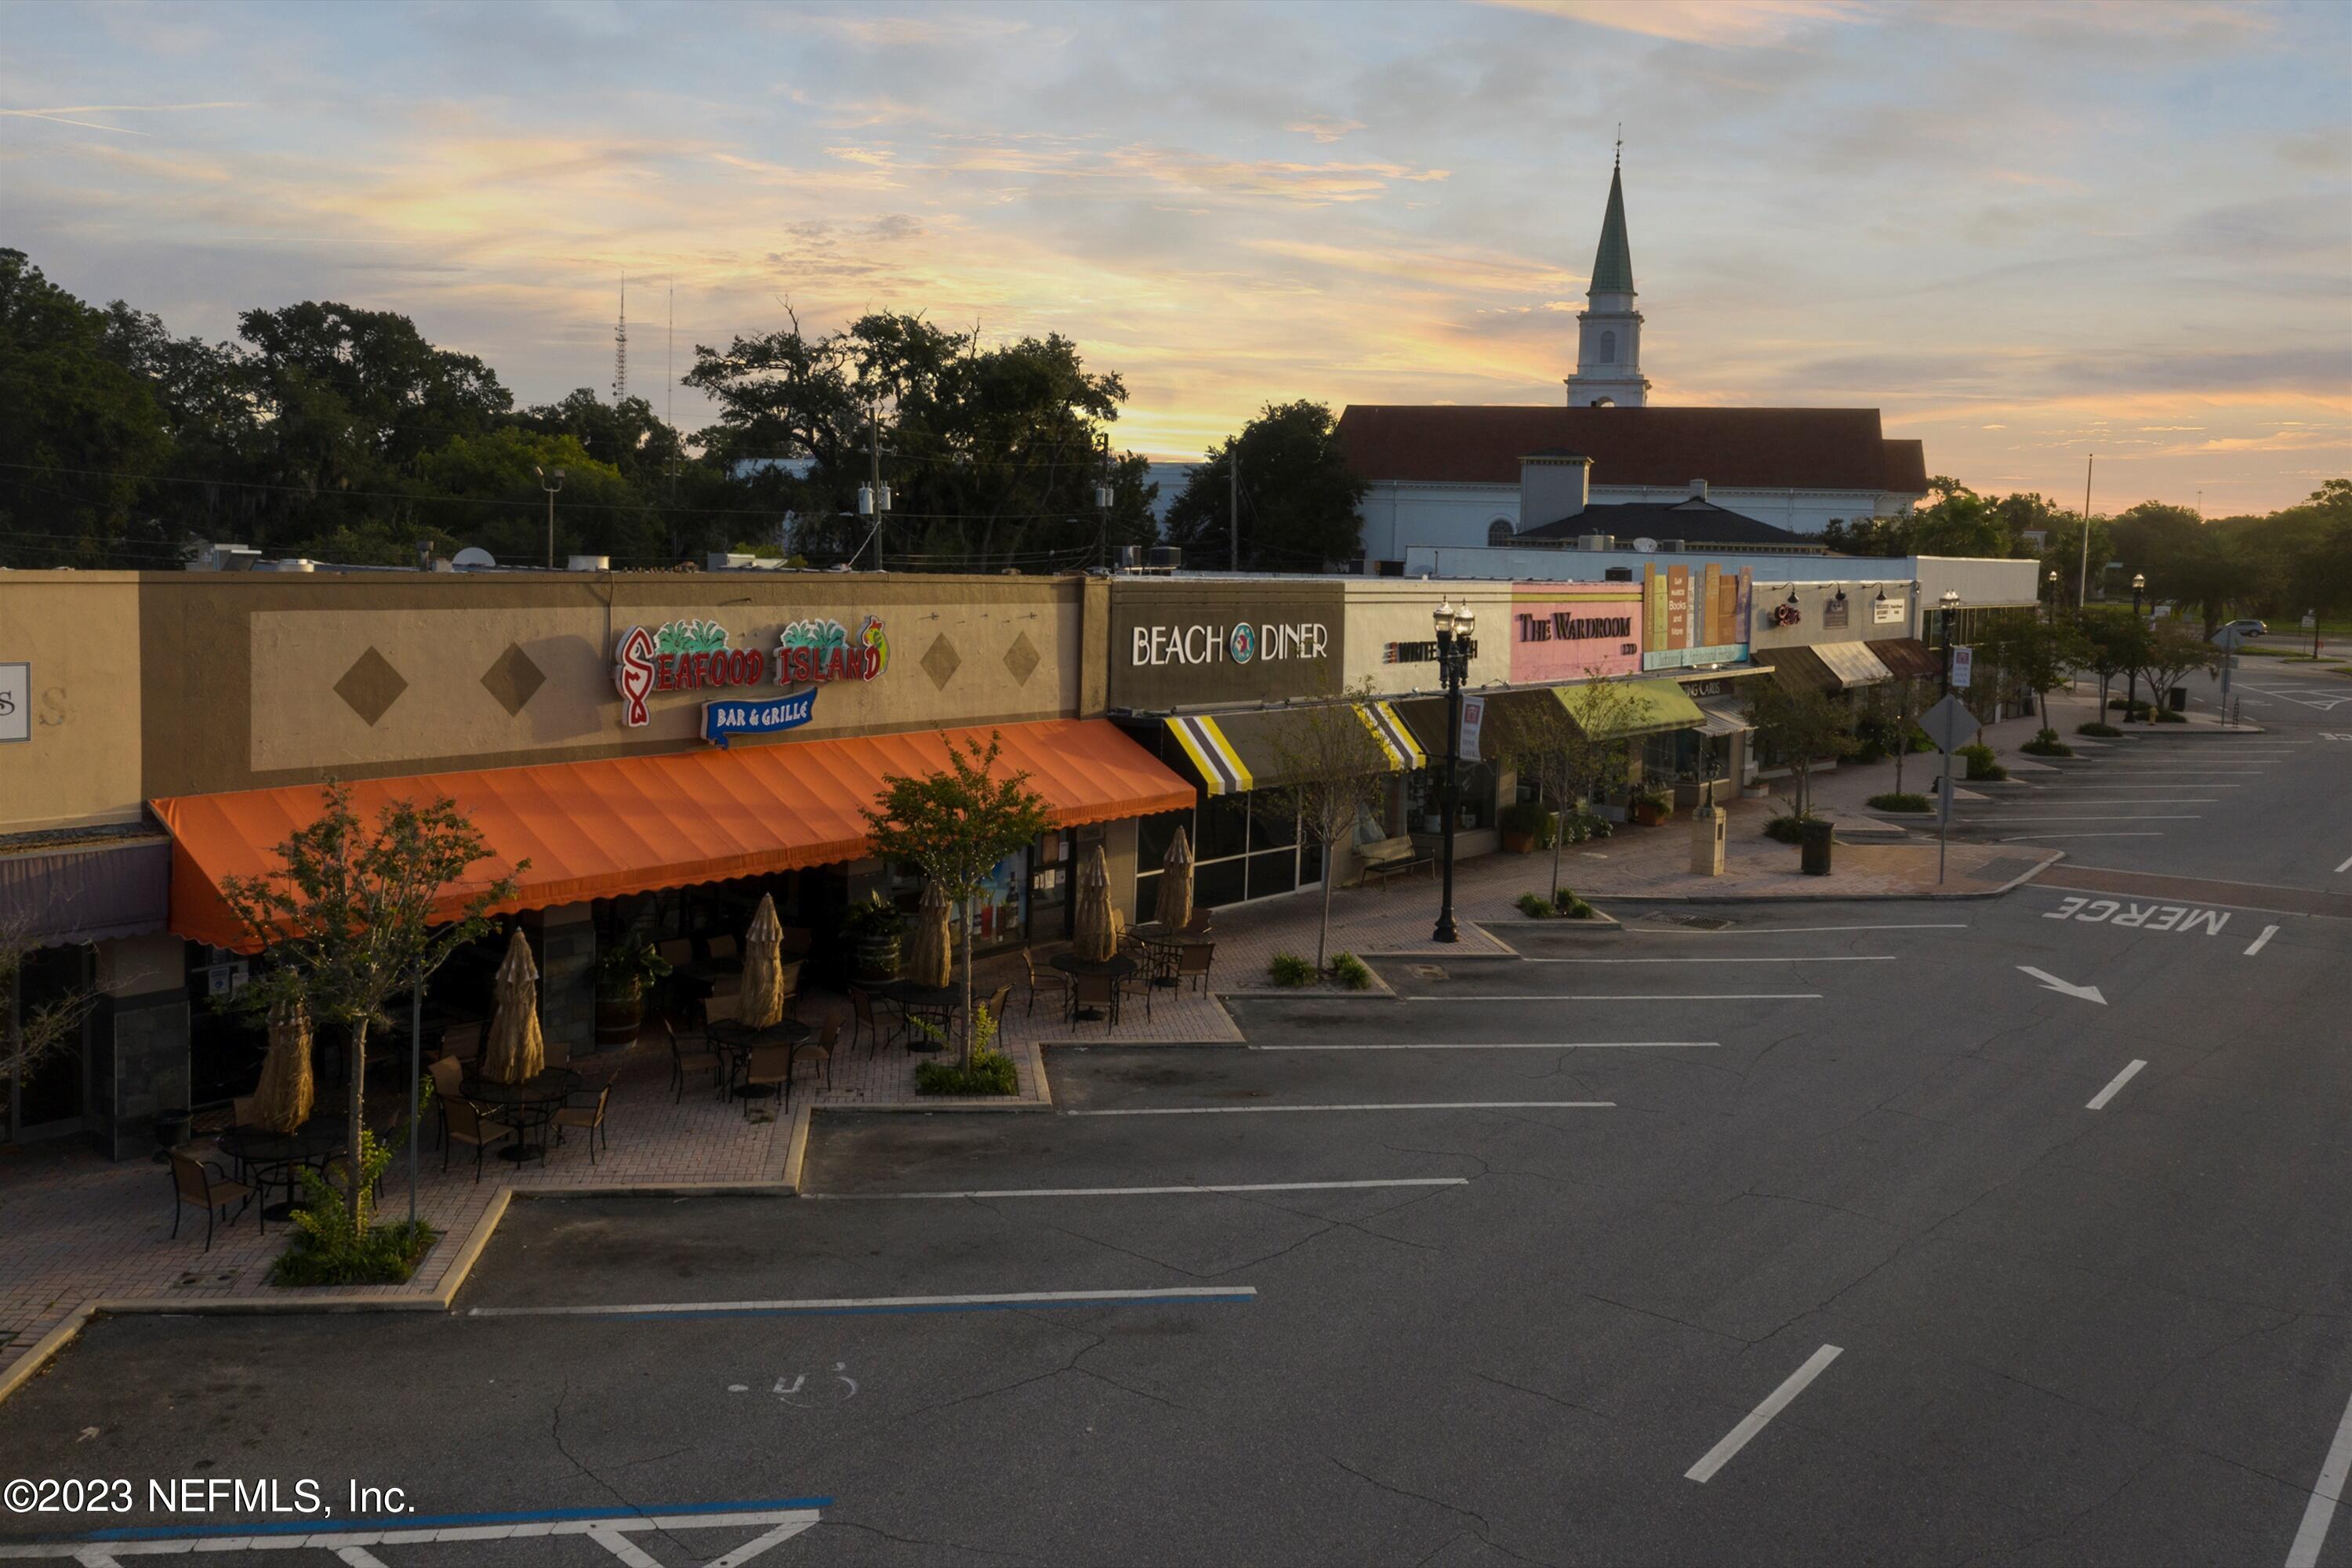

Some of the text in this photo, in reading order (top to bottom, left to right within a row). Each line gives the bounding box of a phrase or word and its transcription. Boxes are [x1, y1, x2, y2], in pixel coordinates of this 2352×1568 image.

[1668, 600, 1686, 610] Books
[1519, 612, 1632, 642] THE WARDROOM
[1133, 623, 1328, 666] BEACH DINER
[622, 626, 882, 725] SEAFOOD ISLAND
[717, 701, 808, 728] BAR & GRILLE
[2042, 896, 2231, 935] MERGE
